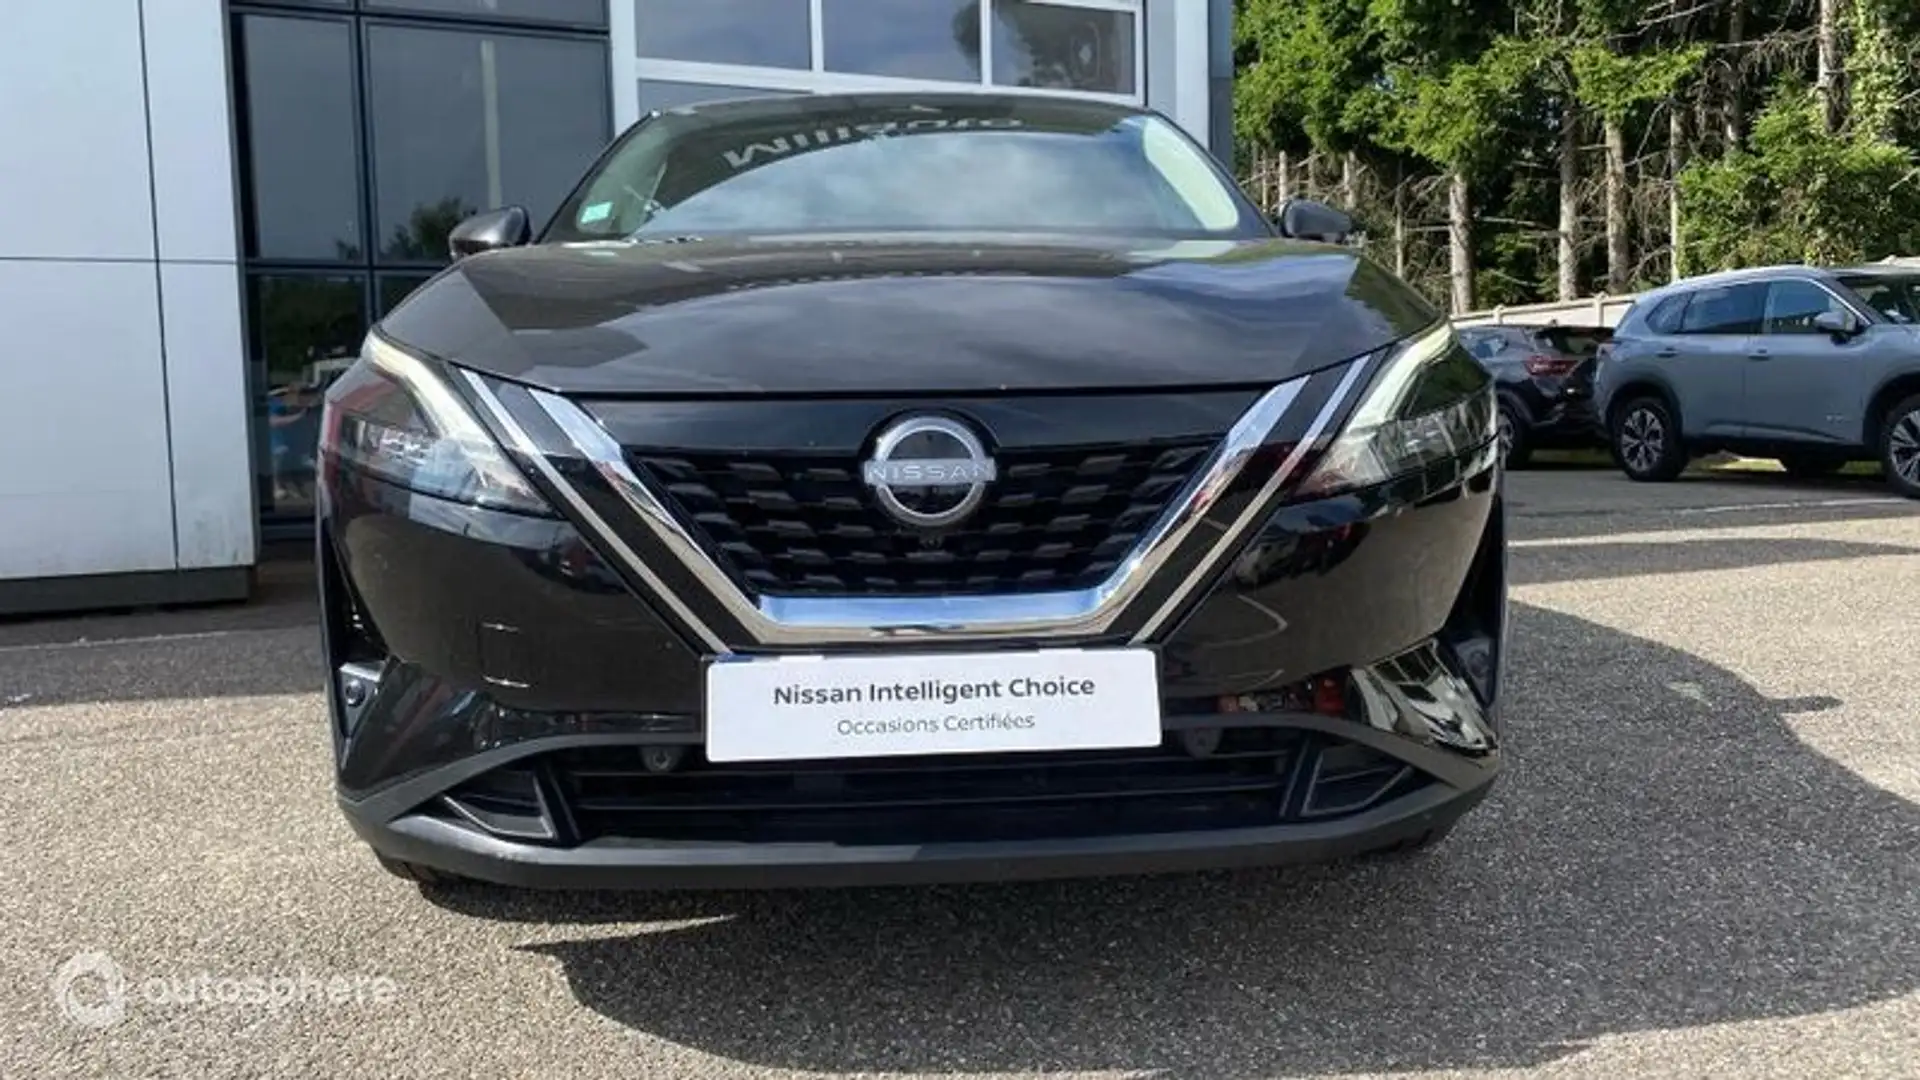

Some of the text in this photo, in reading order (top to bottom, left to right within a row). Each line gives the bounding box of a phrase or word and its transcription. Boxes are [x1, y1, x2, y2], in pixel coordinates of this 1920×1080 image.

[868, 464, 990, 481] NISSAN
[773, 675, 1096, 705] Nissan Intelligent Choice
[836, 711, 1036, 736] Occasions Certifiées
